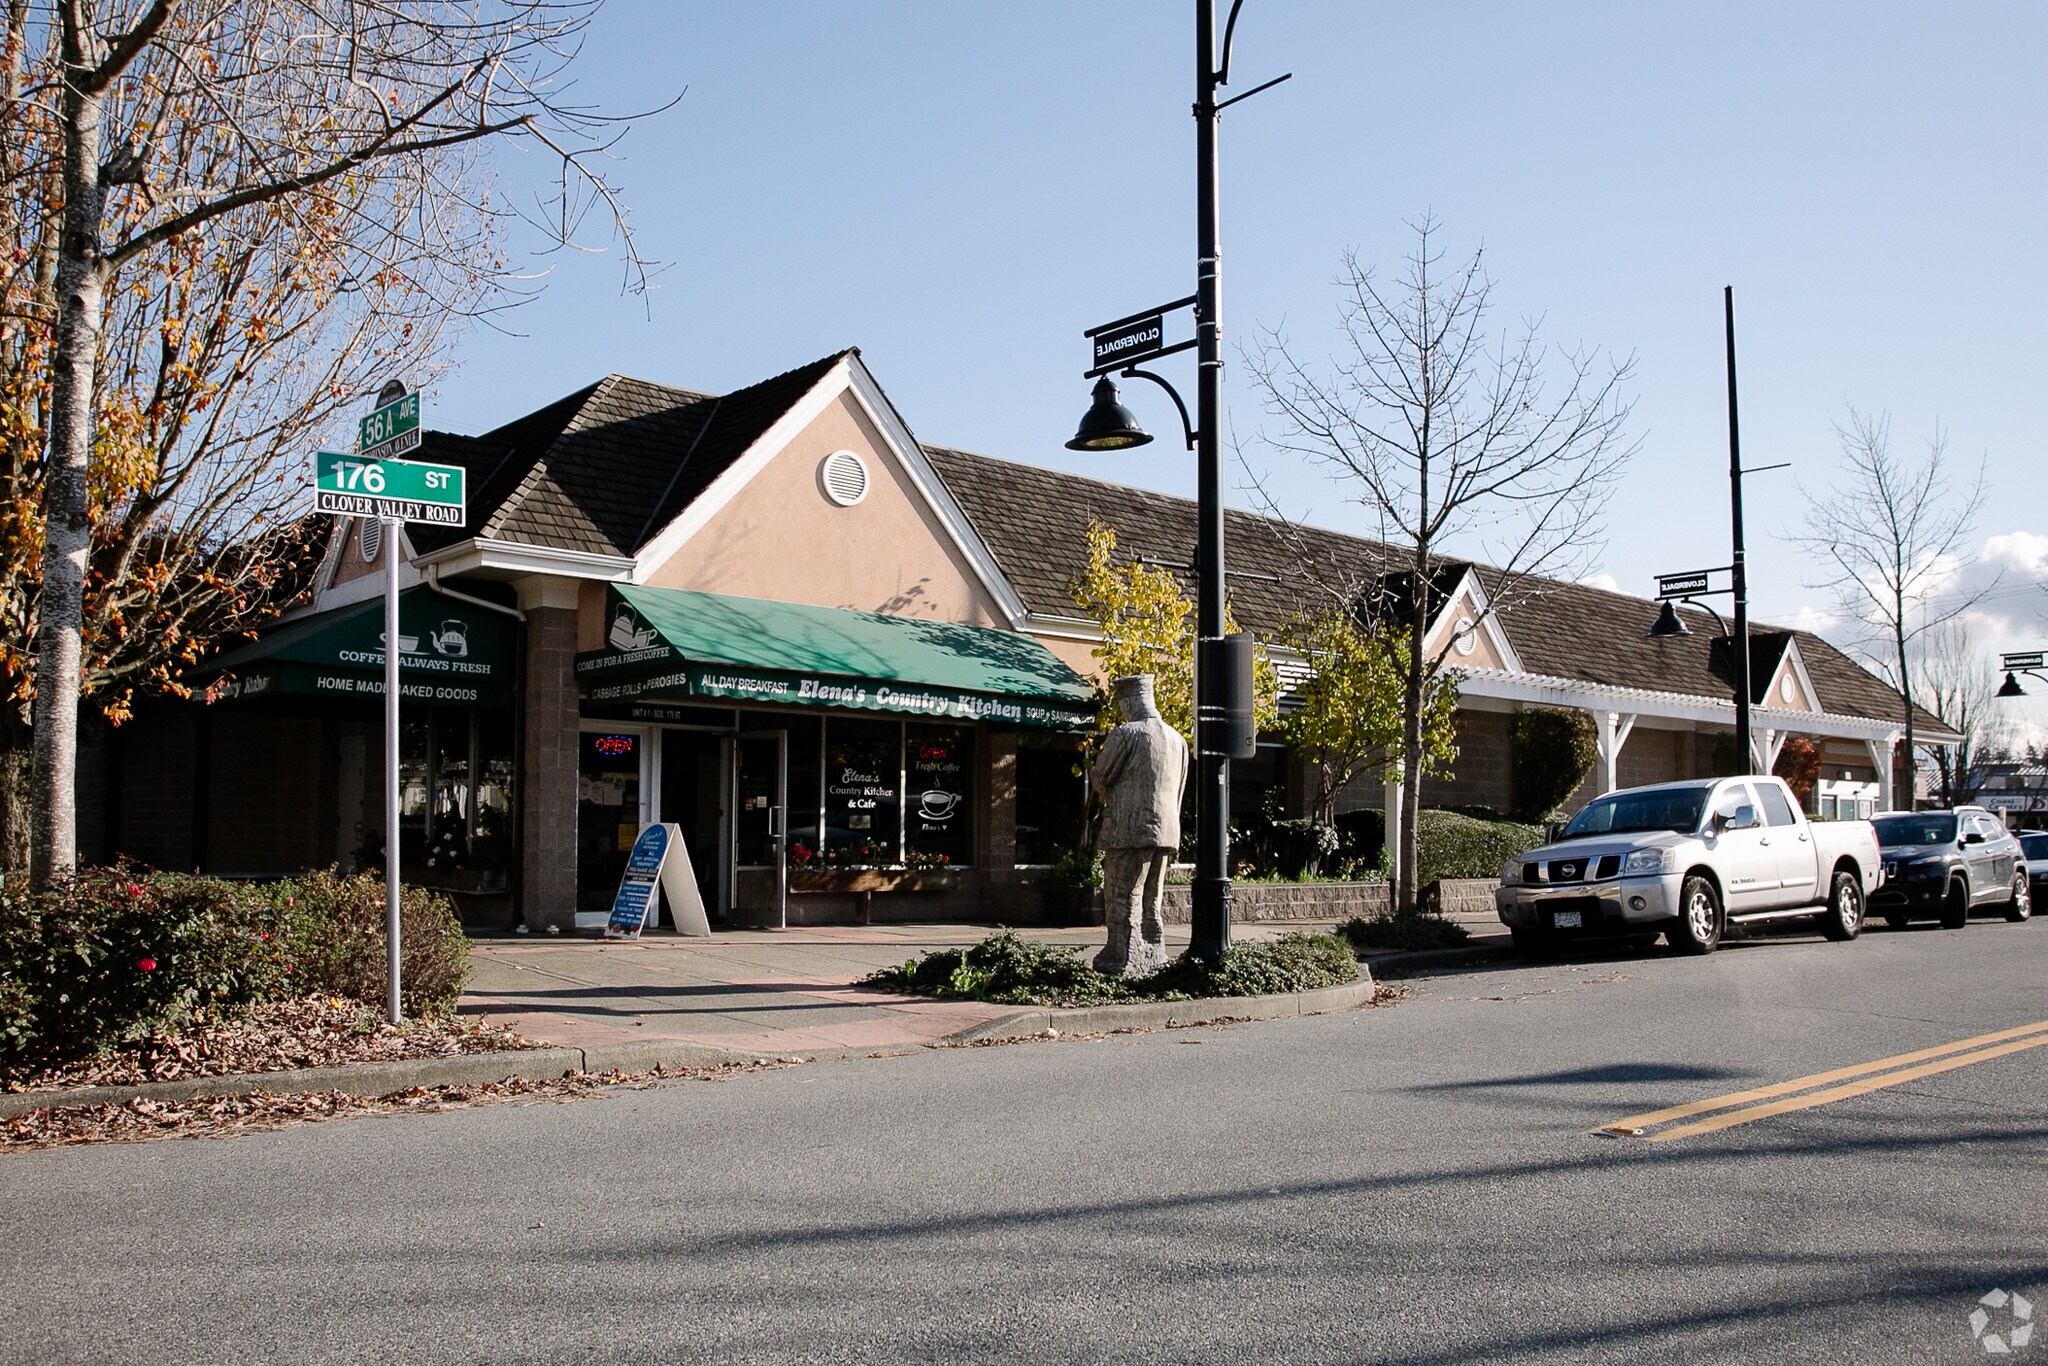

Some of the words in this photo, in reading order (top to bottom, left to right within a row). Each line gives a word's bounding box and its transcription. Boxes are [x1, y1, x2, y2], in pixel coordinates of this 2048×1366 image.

[400, 397, 416, 420] AVE
[331, 461, 386, 493] 176
[425, 471, 451, 489] ST
[321, 494, 373, 514] CLOVER
[376, 499, 422, 518] VALLEY
[425, 507, 459, 522] ROAD
[339, 650, 386, 664] COFFE
[398, 656, 450, 670] ALWAYS
[452, 661, 491, 675] FRESH
[577, 660, 595, 672] COME
[595, 659, 603, 669] IN
[603, 656, 618, 667] FOR
[617, 655, 622, 664] A
[623, 650, 643, 663] FRESH
[643, 647, 670, 660] COFFEE
[317, 677, 354, 691] HOME
[436, 687, 477, 701] GOODS
[592, 686, 621, 700] CABBAGE
[622, 683, 641, 696] ROLLS
[646, 673, 687, 690] PEROGIES
[701, 673, 718, 689] ALL
[718, 675, 738, 690] DAY
[738, 677, 789, 695] BREAKFAST
[798, 679, 865, 703] Elena's
[876, 686, 949, 713] Country
[956, 695, 1022, 719] Kitchen
[1026, 707, 1045, 719] SOUP
[595, 738, 632, 752] OPEN
[920, 747, 947, 759] OPEN
[842, 767, 880, 784] Elena's
[916, 761, 937, 772] Fresh
[937, 762, 960, 774] Coffee
[829, 786, 862, 798] Country
[863, 787, 894, 797] Kitchen
[848, 800, 857, 808] &
[857, 799, 876, 809] Cafe
